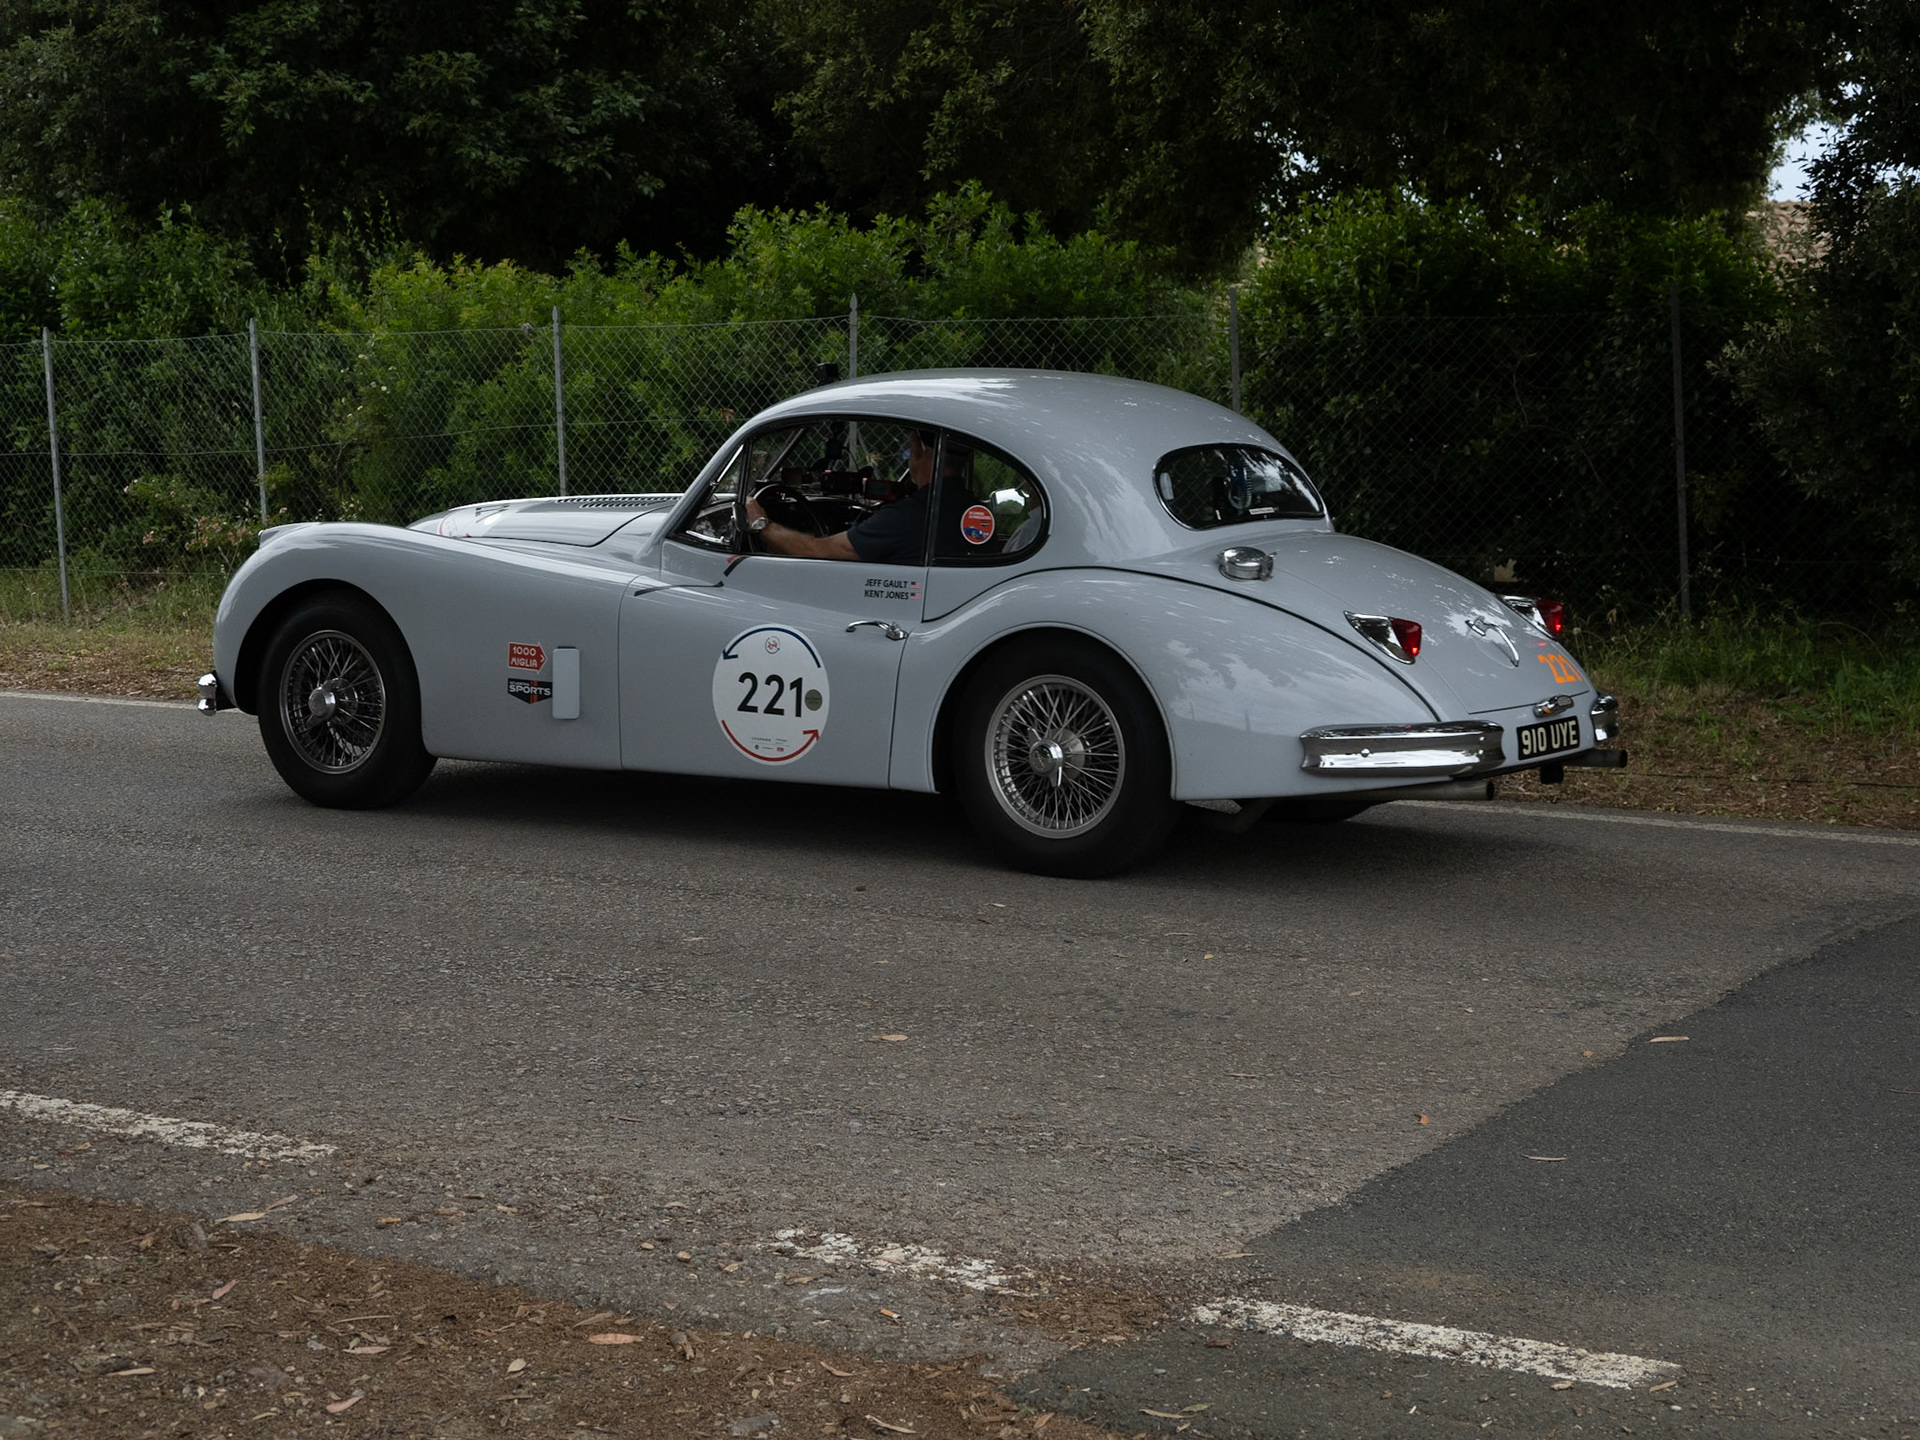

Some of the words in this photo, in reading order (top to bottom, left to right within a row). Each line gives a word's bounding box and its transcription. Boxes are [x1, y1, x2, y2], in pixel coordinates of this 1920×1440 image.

[865, 579, 882, 587] JEFF
[883, 580, 908, 588] GAULT
[864, 590, 884, 598] KENT
[885, 591, 909, 600] JONES
[513, 646, 536, 656] 1000
[510, 657, 538, 667] MIGLIA
[1537, 653, 1582, 684] 221
[509, 684, 551, 696] SPORTS
[737, 672, 803, 718] 221
[1521, 726, 1547, 755] 910
[1550, 720, 1577, 749] UYE
